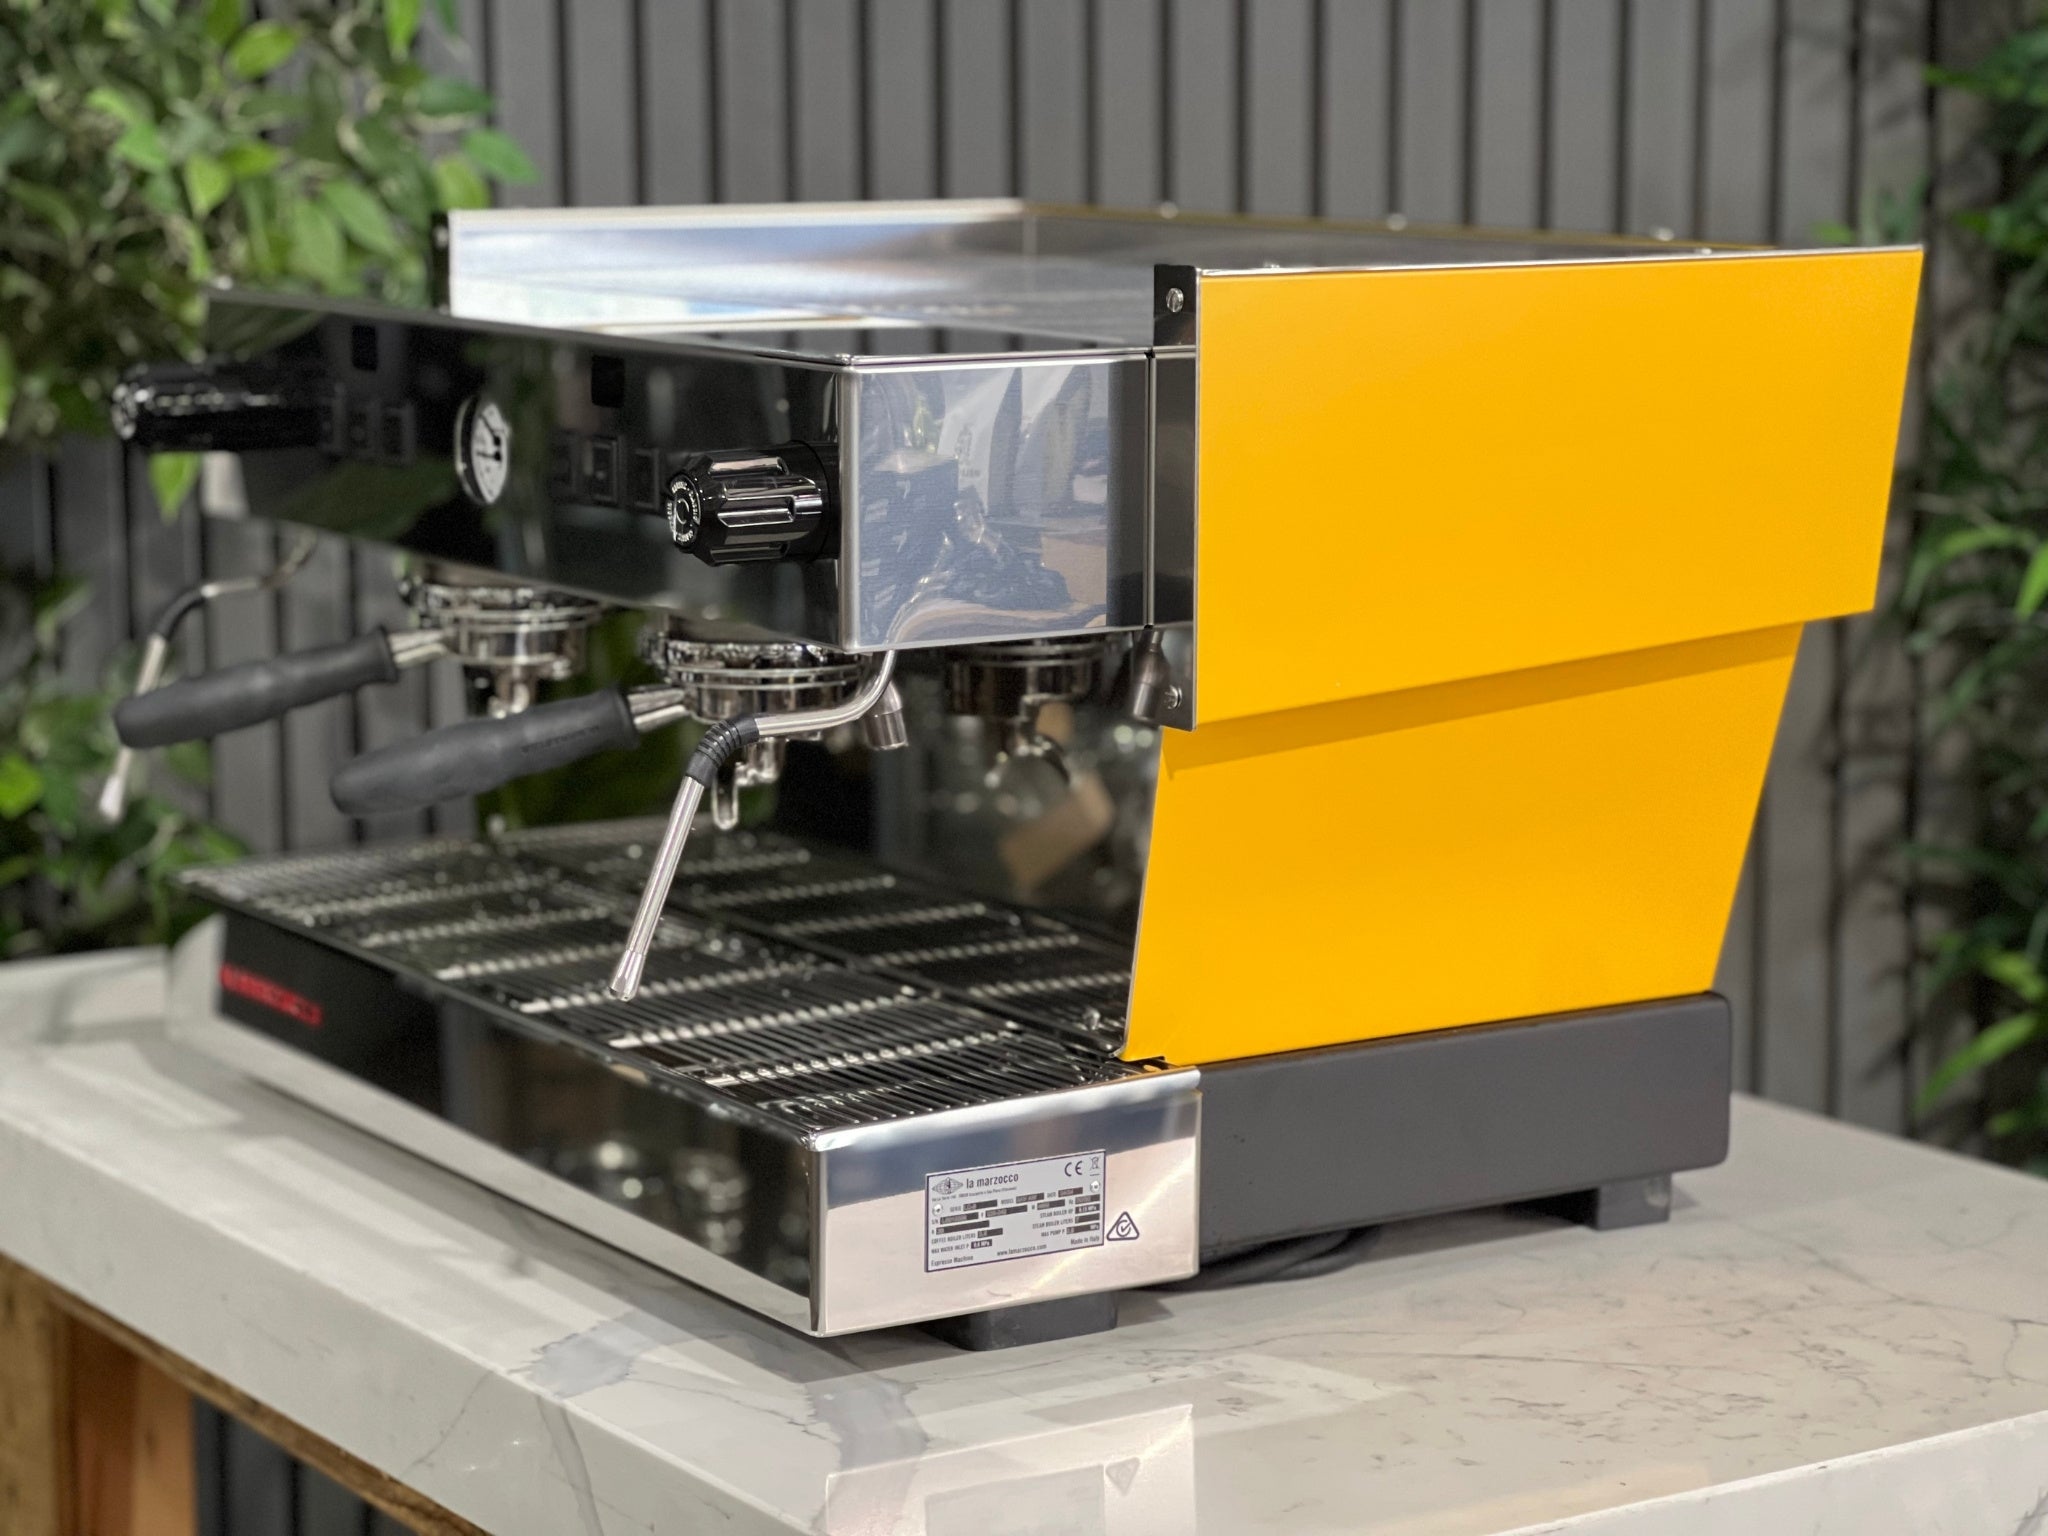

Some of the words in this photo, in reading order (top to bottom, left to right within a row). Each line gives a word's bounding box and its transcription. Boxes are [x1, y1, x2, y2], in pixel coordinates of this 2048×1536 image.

[1065, 1161, 1083, 1177] CE
[967, 1179, 974, 1189] la
[977, 1174, 1019, 1186] marzocco
[997, 1245, 1047, 1256] www.lamarzocco.com
[931, 1258, 953, 1267] Espresso
[954, 1255, 973, 1263] Machine
